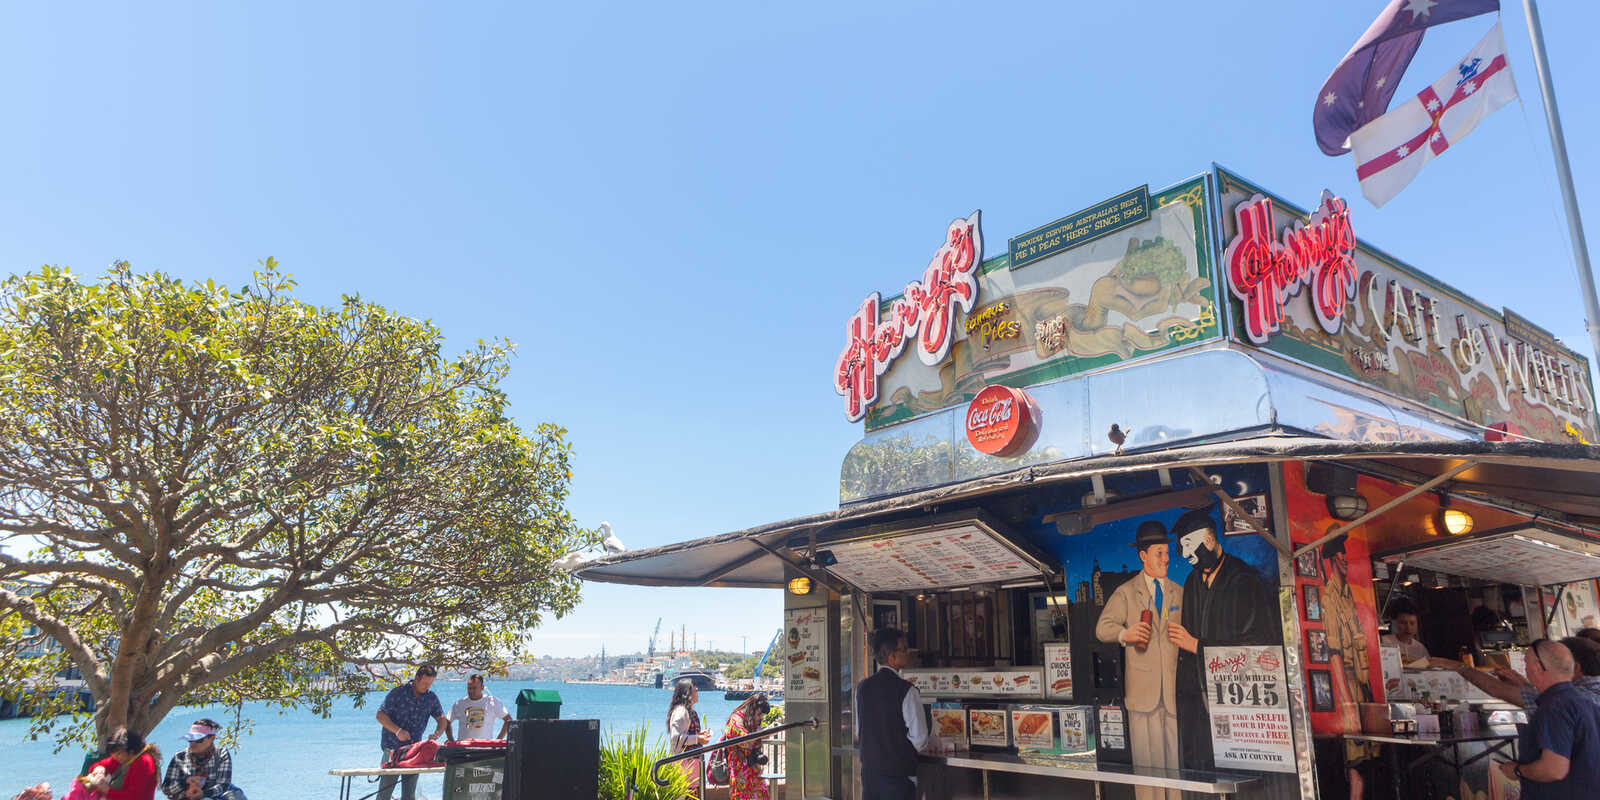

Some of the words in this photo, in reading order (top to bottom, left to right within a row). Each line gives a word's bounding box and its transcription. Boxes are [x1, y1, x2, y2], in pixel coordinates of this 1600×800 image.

[1015, 250, 1028, 260] PIE
[1038, 237, 1060, 252] PEAS
[1094, 213, 1121, 231] SINCE
[1122, 204, 1144, 220] 1945
[1017, 233, 1044, 250] PROUDLY
[1045, 222, 1074, 239] SERVING
[1075, 204, 1119, 227] AUSTRALIA'S
[1119, 196, 1139, 210] BEST
[1225, 190, 1358, 344] Harry's
[835, 209, 983, 422] Harry's
[980, 319, 1020, 348] Pies
[1208, 651, 1247, 675] Harry's
[1244, 674, 1278, 682] WHEELS
[1213, 682, 1280, 707] 1945
[1255, 713, 1288, 722] SELFIE
[1265, 731, 1289, 739] FREE
[1239, 752, 1249, 760] AT
[1249, 753, 1284, 761] COUNTER
